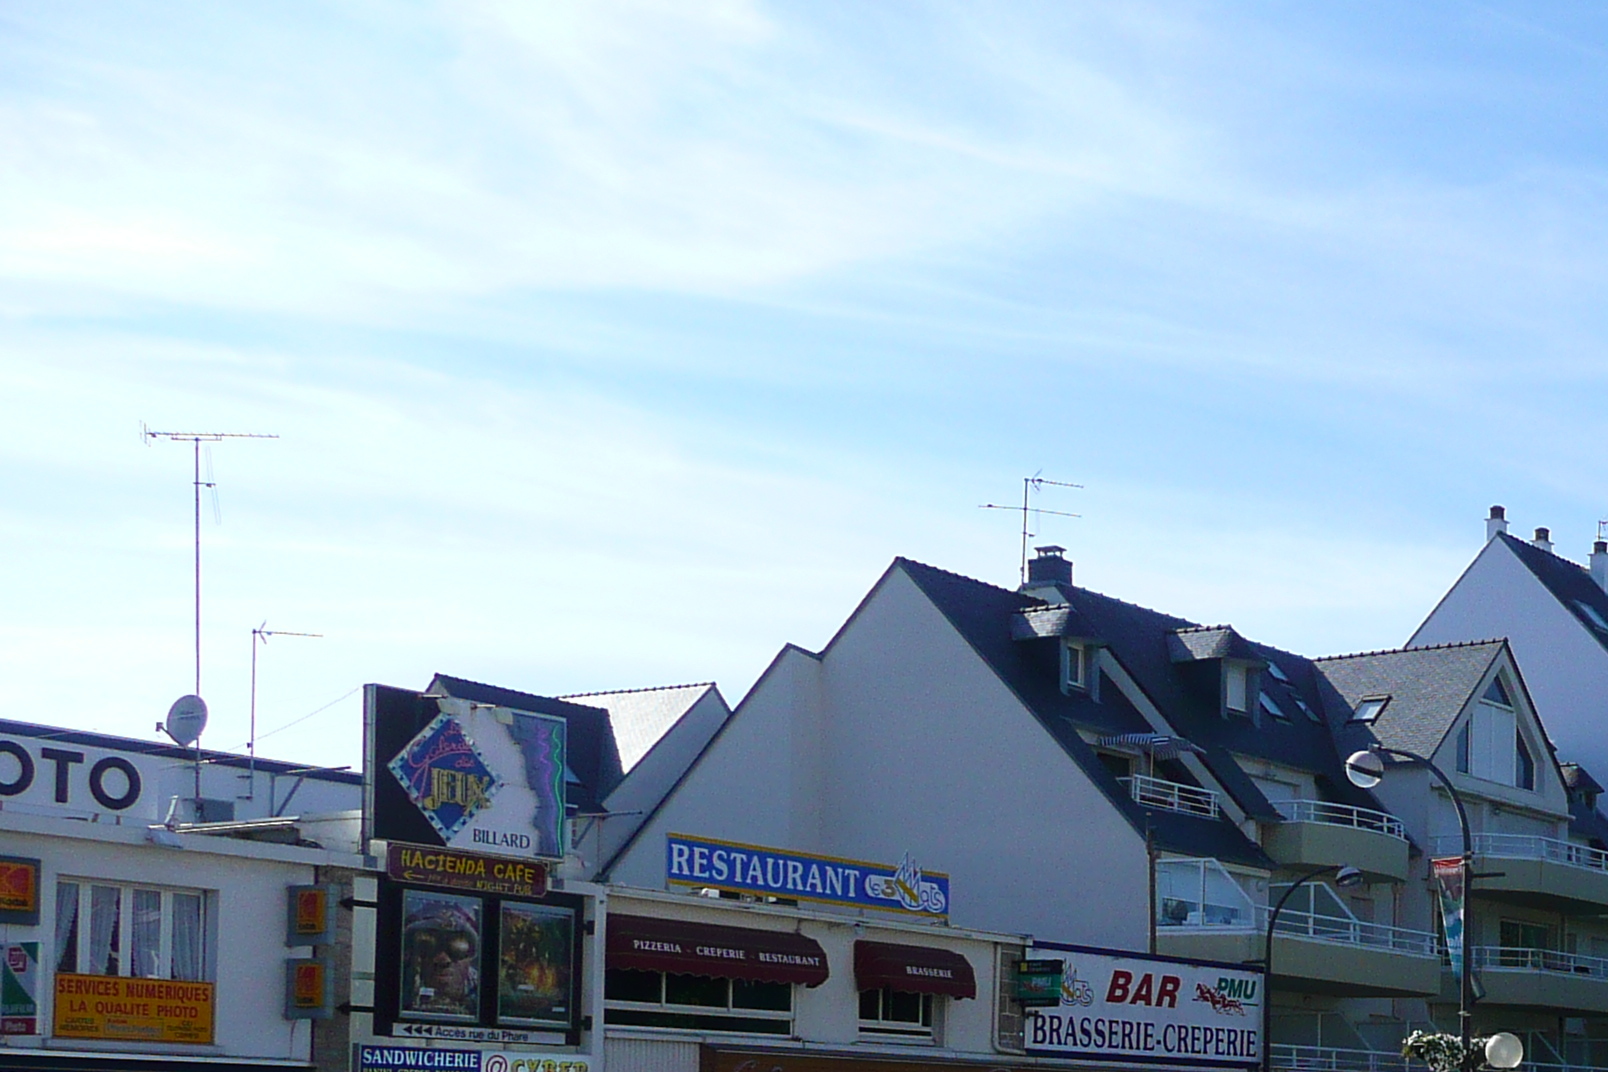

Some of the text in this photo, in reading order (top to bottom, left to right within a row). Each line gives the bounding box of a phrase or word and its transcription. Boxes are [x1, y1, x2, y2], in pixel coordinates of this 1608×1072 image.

[473, 828, 531, 849] BILLARD
[401, 850, 486, 877] HACIENDA
[493, 863, 536, 884] CAFE
[671, 843, 860, 898] RESTAURANT
[881, 878, 897, 898] 3
[476, 880, 511, 892] NIGHT
[633, 939, 820, 967] PIZZERIA CREPERIE RESTAURANT
[905, 965, 953, 979] BRASSERIE
[58, 978, 209, 1004] SERVICES NUMERIQUES
[1106, 969, 1181, 1009] BAR
[1216, 977, 1257, 1000] PMU
[69, 1000, 199, 1018] LA QUALITE PHOTO
[468, 1030, 485, 1040] rue
[487, 1030, 500, 1040] du
[502, 1031, 529, 1042] Phare
[1032, 1013, 1258, 1058] BRASSERIE-CREPERIE
[362, 1048, 479, 1068] SANDWICHERIE
